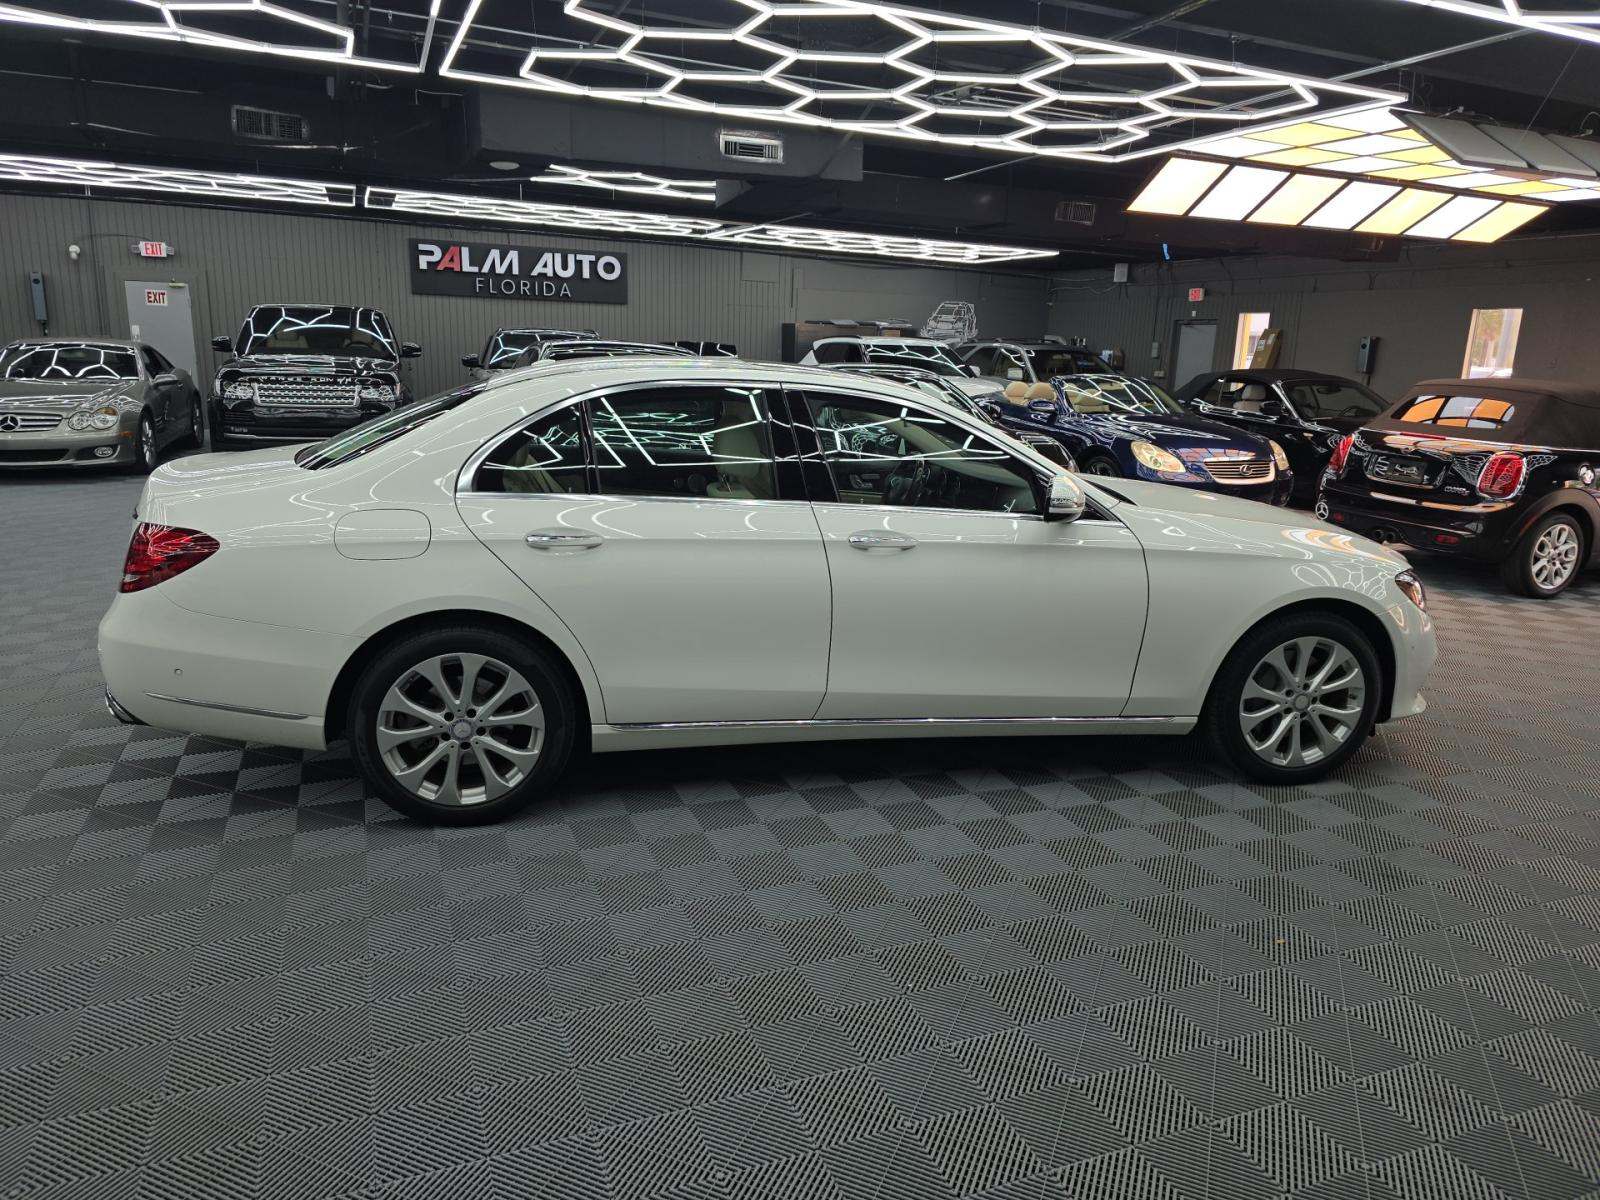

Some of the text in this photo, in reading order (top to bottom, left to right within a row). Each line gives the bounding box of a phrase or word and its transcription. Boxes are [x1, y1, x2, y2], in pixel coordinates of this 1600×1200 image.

[144, 242, 163, 256] EXIT
[418, 243, 622, 281] PALM AUTO
[475, 277, 572, 297] FLORIDA
[146, 291, 166, 305] EXIT
